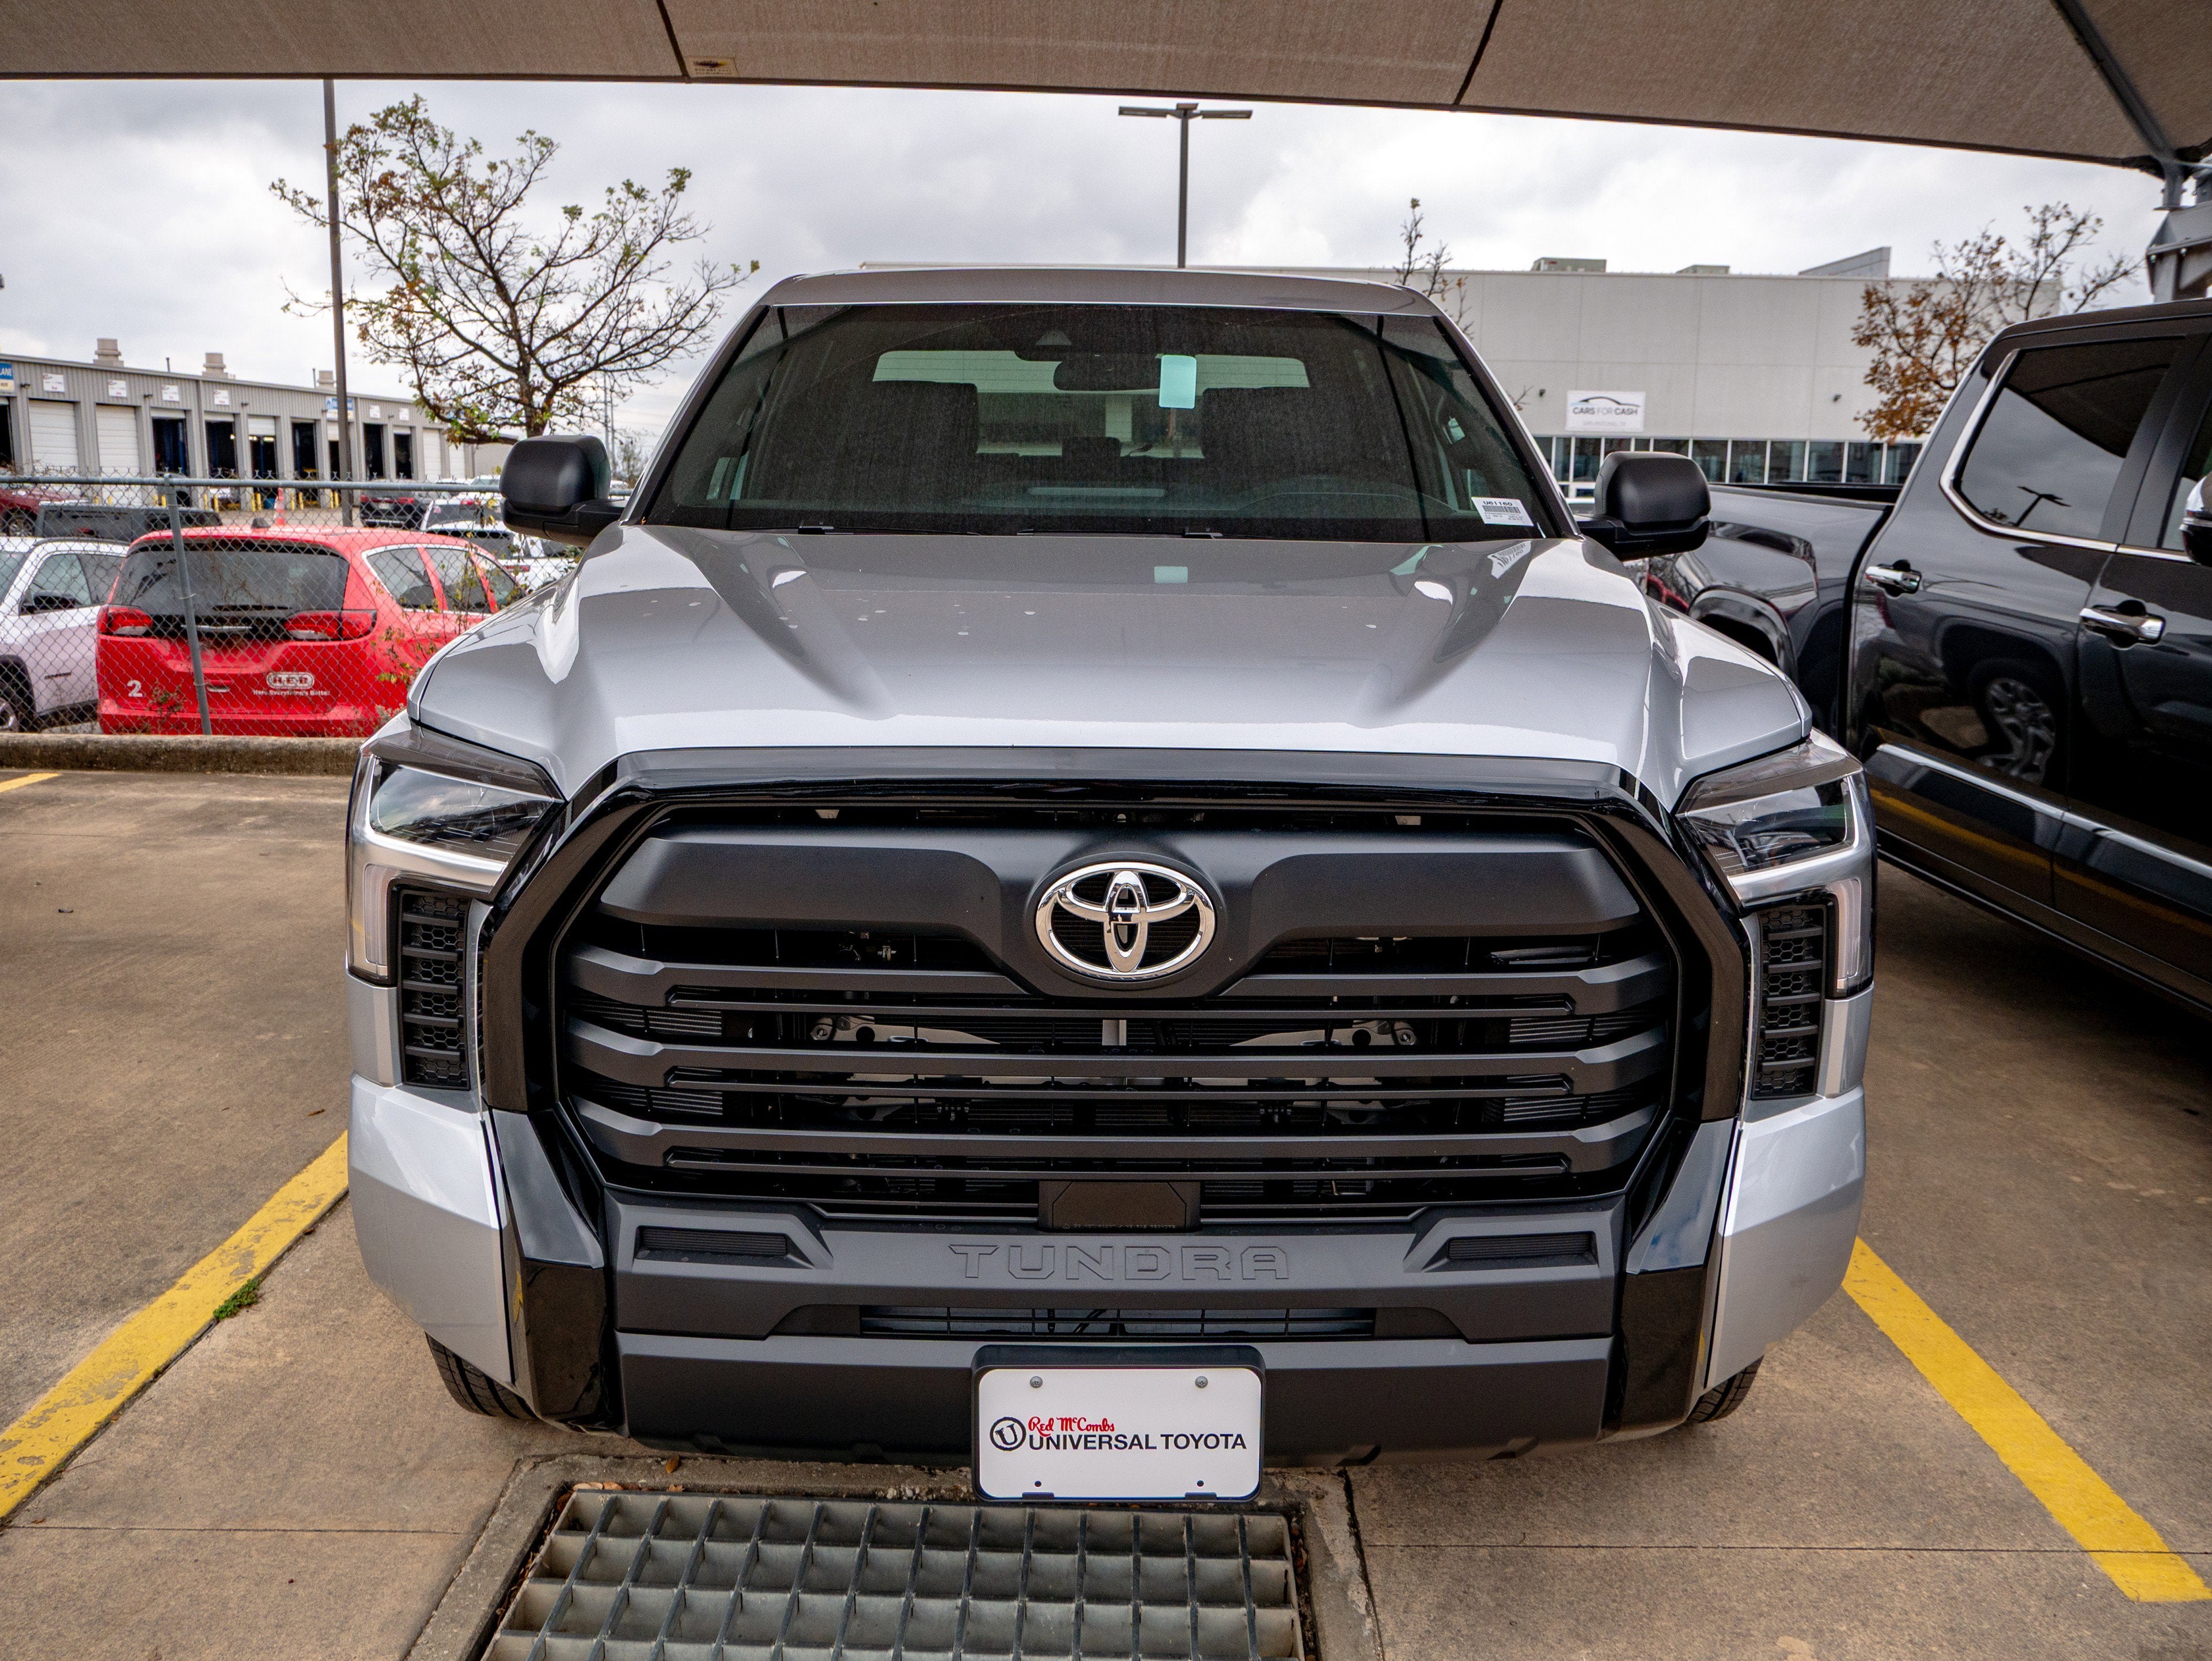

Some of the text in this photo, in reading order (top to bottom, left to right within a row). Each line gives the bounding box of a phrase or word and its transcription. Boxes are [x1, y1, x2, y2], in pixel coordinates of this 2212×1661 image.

[126, 680, 143, 697] 2
[948, 1244, 1289, 1280] TUNDRA
[1028, 1416, 1115, 1437] Red McCombs
[1029, 1433, 1247, 1450] UNIVERSAL TOYOTA
